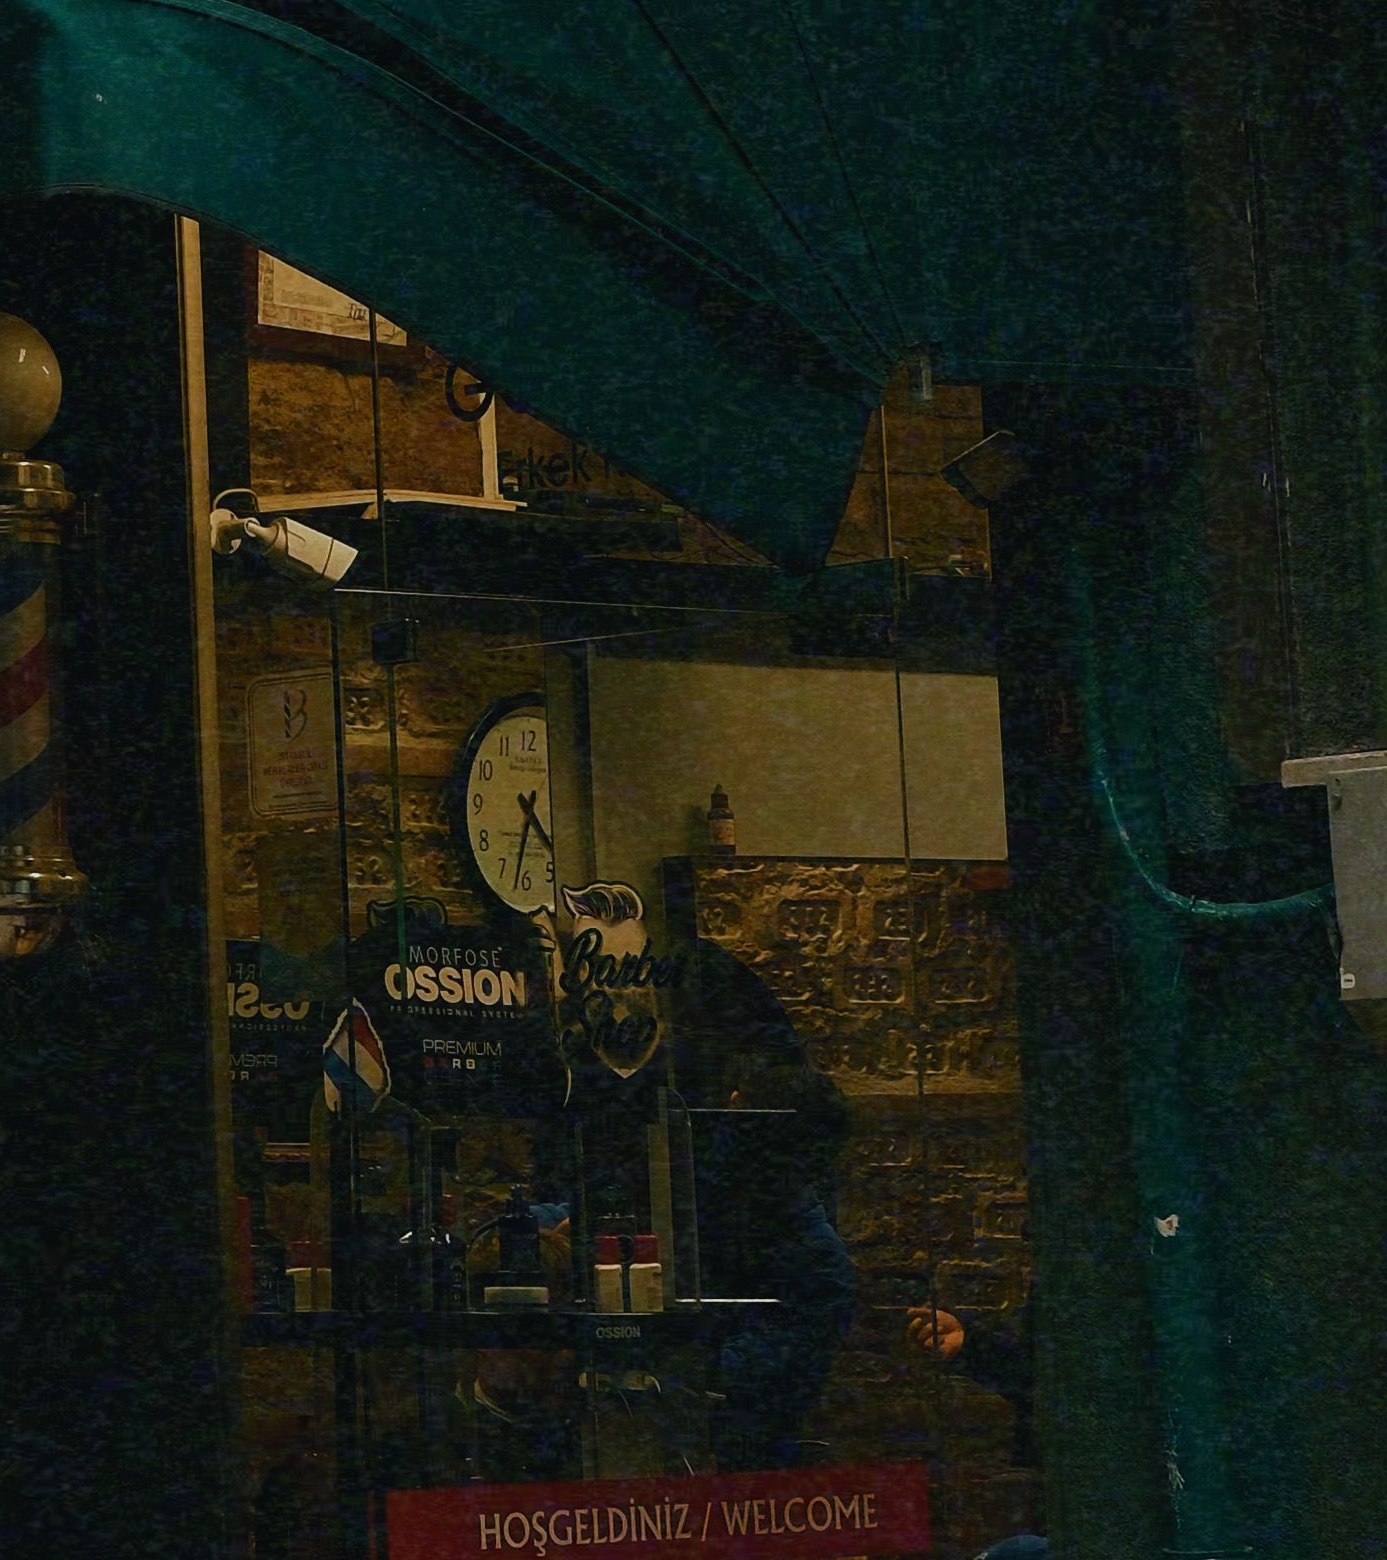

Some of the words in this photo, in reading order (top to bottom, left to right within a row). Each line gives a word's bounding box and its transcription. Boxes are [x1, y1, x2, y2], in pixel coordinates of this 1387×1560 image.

[499, 735, 509, 757] 11
[521, 730, 537, 751] 12
[478, 759, 493, 781] 10
[473, 793, 483, 816] 9
[478, 829, 490, 852] 8
[497, 857, 506, 880] 7
[545, 861, 555, 883] 5
[521, 870, 532, 892] 6
[409, 944, 500, 968] MORFOSE
[560, 927, 690, 993] Barber
[384, 962, 528, 1008] OSSION
[422, 1038, 503, 1056] PREMIUM
[595, 1325, 641, 1339] OSSION
[479, 1496, 692, 1557] HOŞGELDİNİZ
[700, 1501, 713, 1542] /
[721, 1492, 879, 1537] WELCOME
